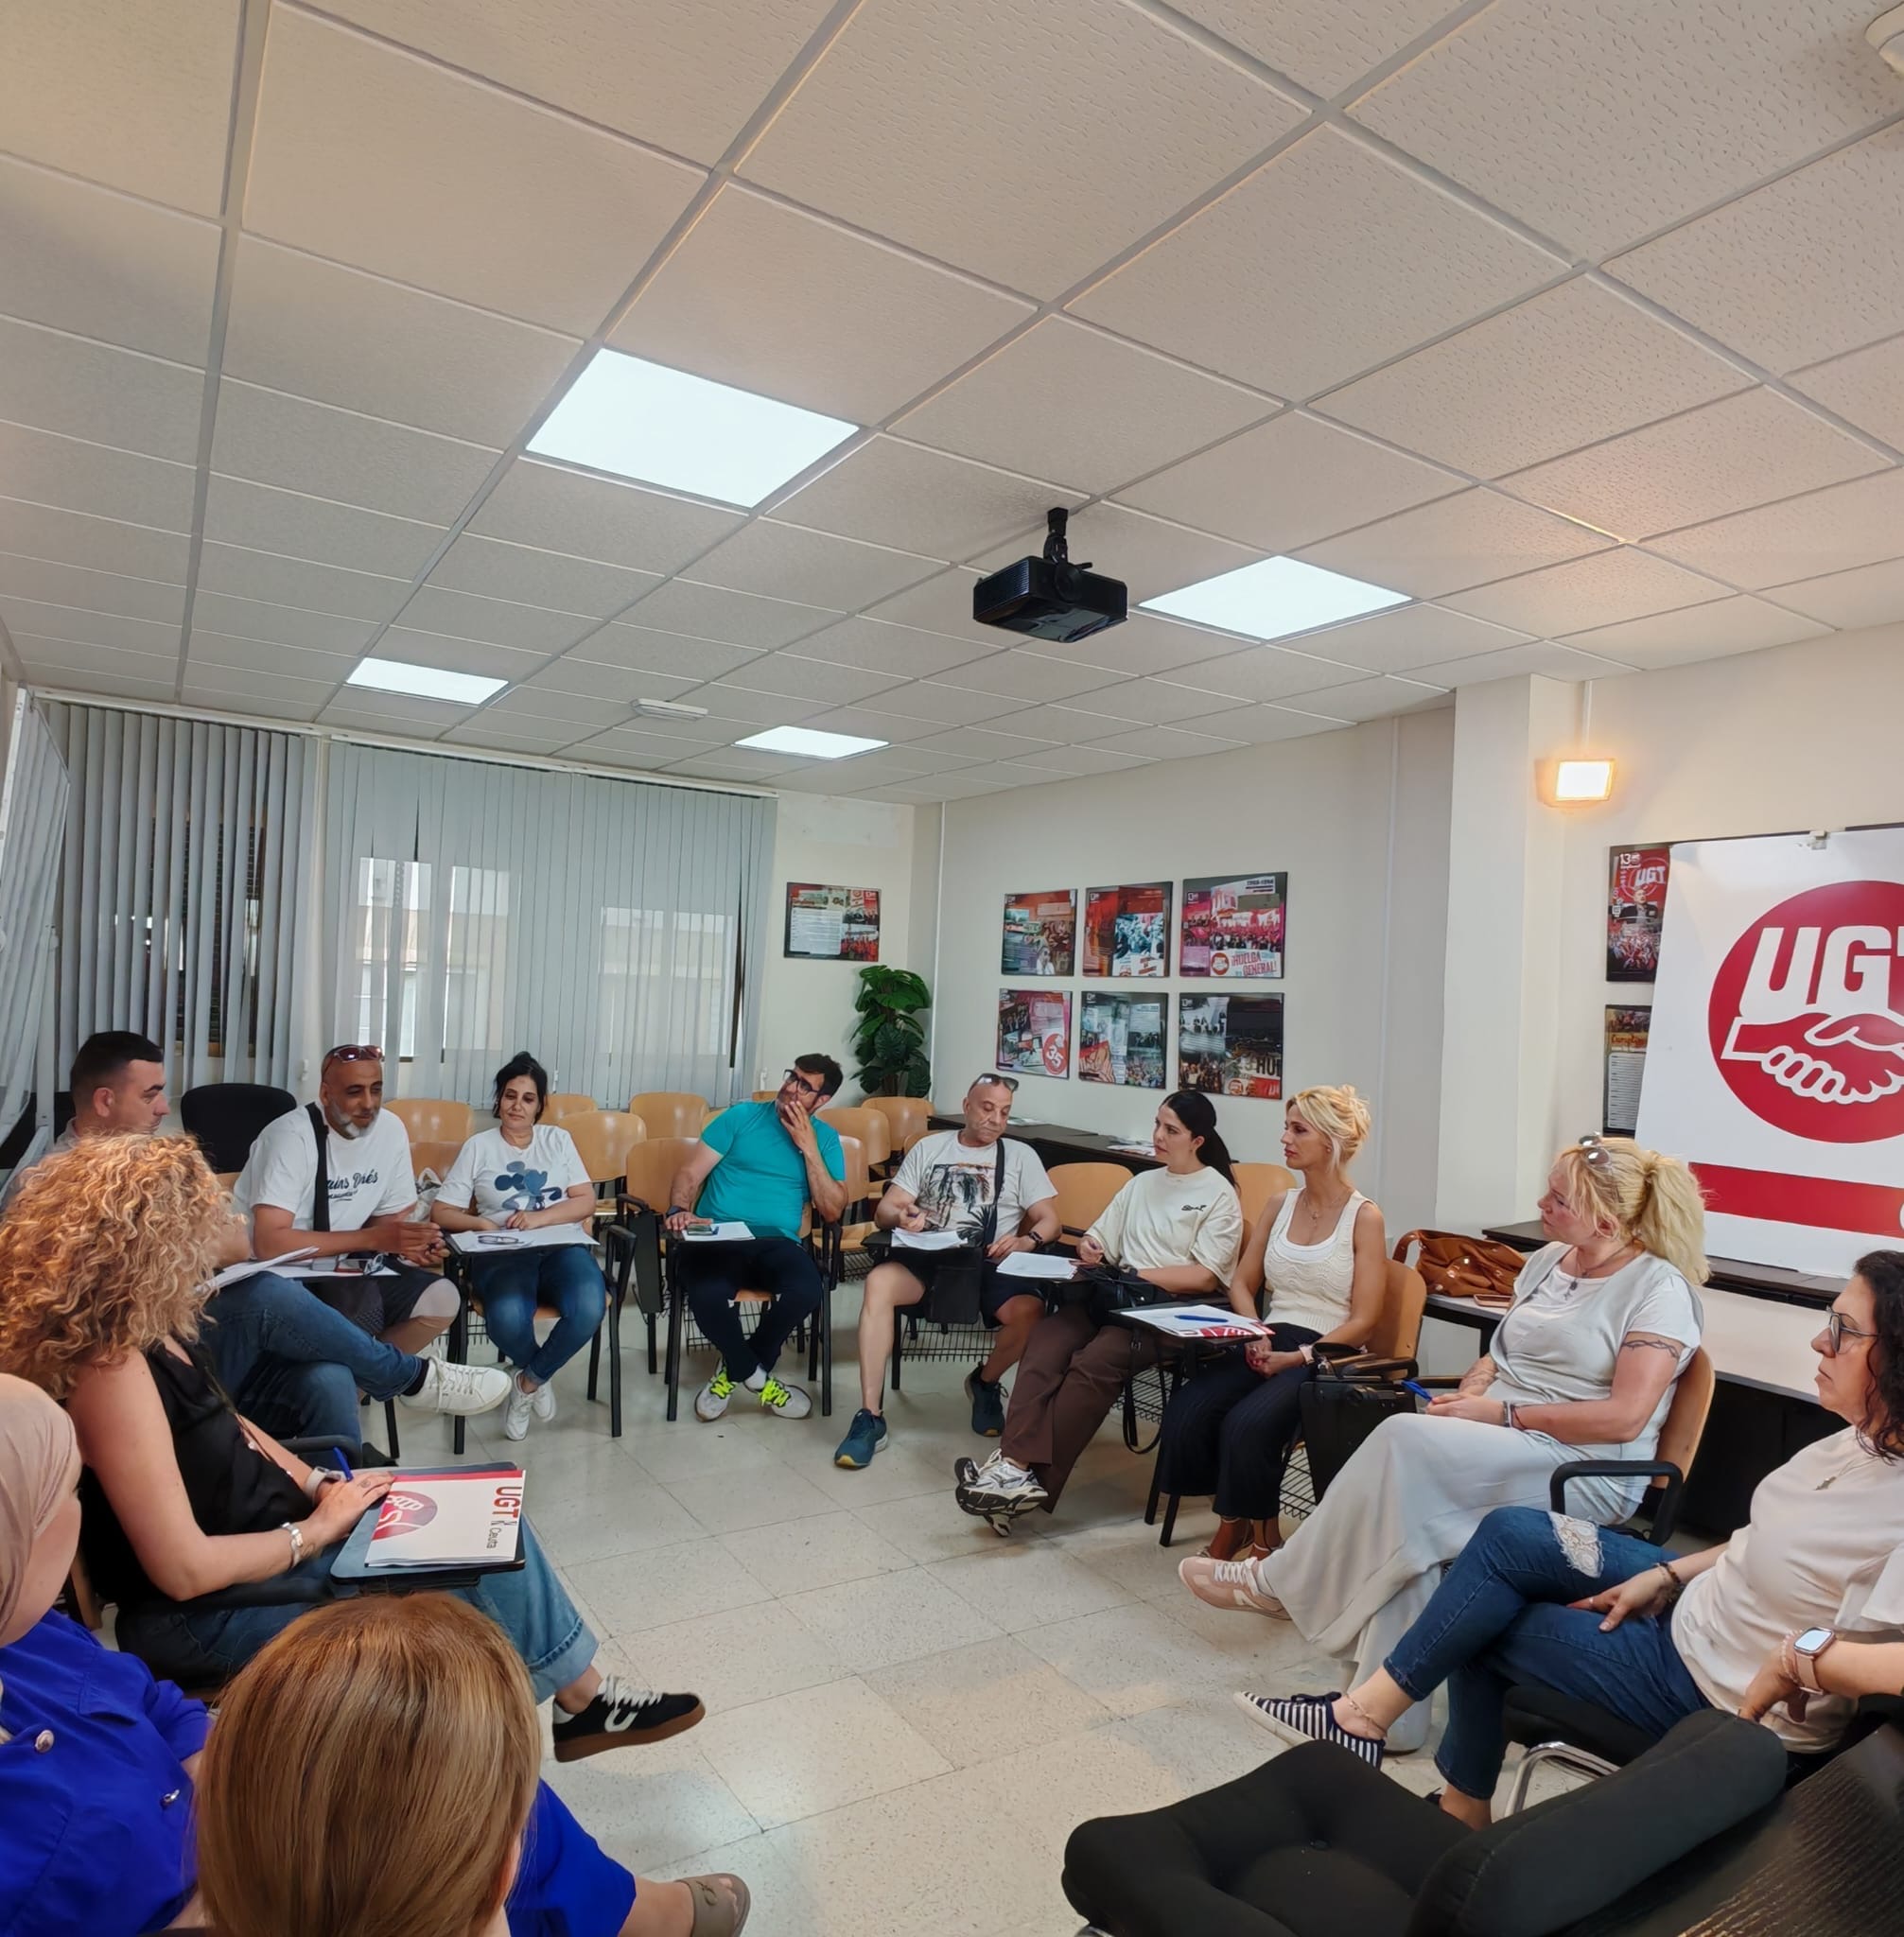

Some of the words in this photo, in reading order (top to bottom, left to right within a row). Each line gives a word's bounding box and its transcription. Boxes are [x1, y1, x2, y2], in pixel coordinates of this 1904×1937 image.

[1634, 865, 1666, 886] UGT
[1738, 925, 1904, 1021] UG
[492, 1486, 522, 1519] UGT
[486, 1527, 502, 1549] Ceuta
